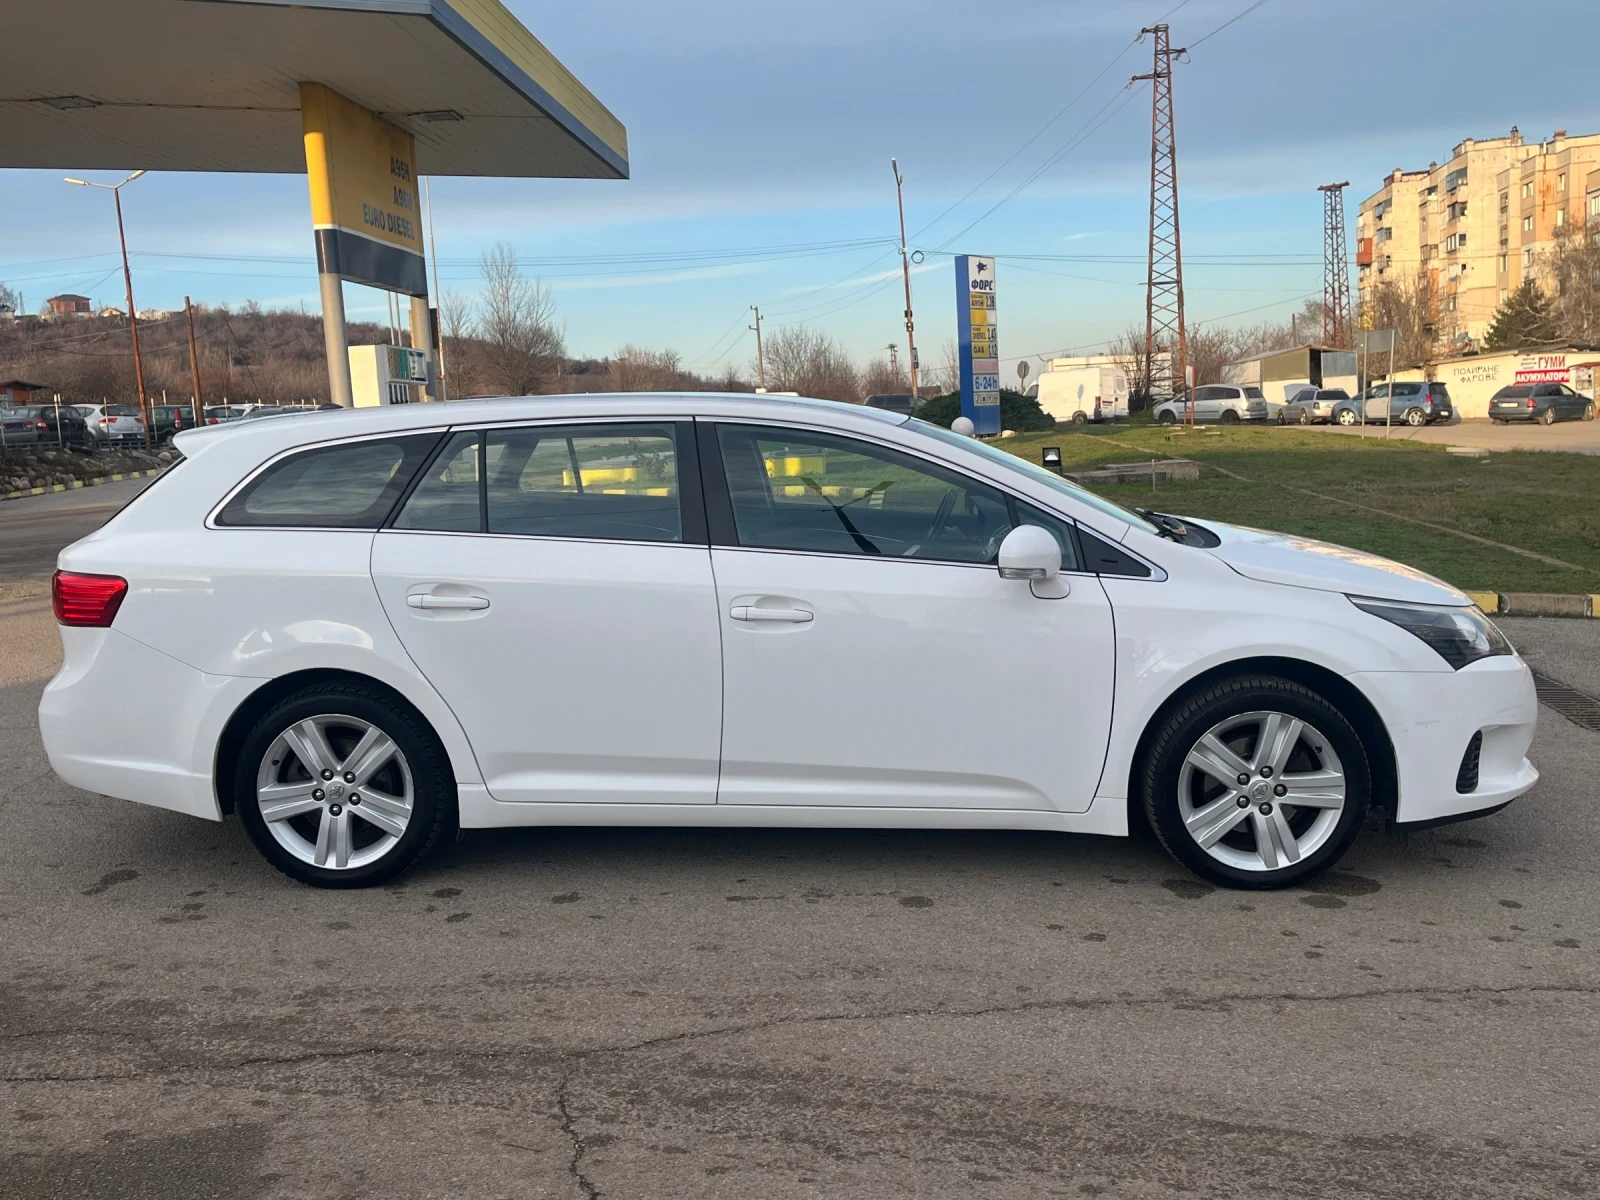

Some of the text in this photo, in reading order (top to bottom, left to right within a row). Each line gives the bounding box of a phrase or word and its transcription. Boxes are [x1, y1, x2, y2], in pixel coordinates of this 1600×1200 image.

[363, 202, 415, 240] EURO DIESEL
[971, 279, 993, 290] ФОРС
[972, 332, 987, 340] DIESEL
[1538, 355, 1566, 369] ГУМИ
[1453, 364, 1500, 376] ПОЛИРАНЕ
[1460, 373, 1498, 383] ФАРОВЕ
[1516, 371, 1569, 382] АКУМУЛАТОРИ
